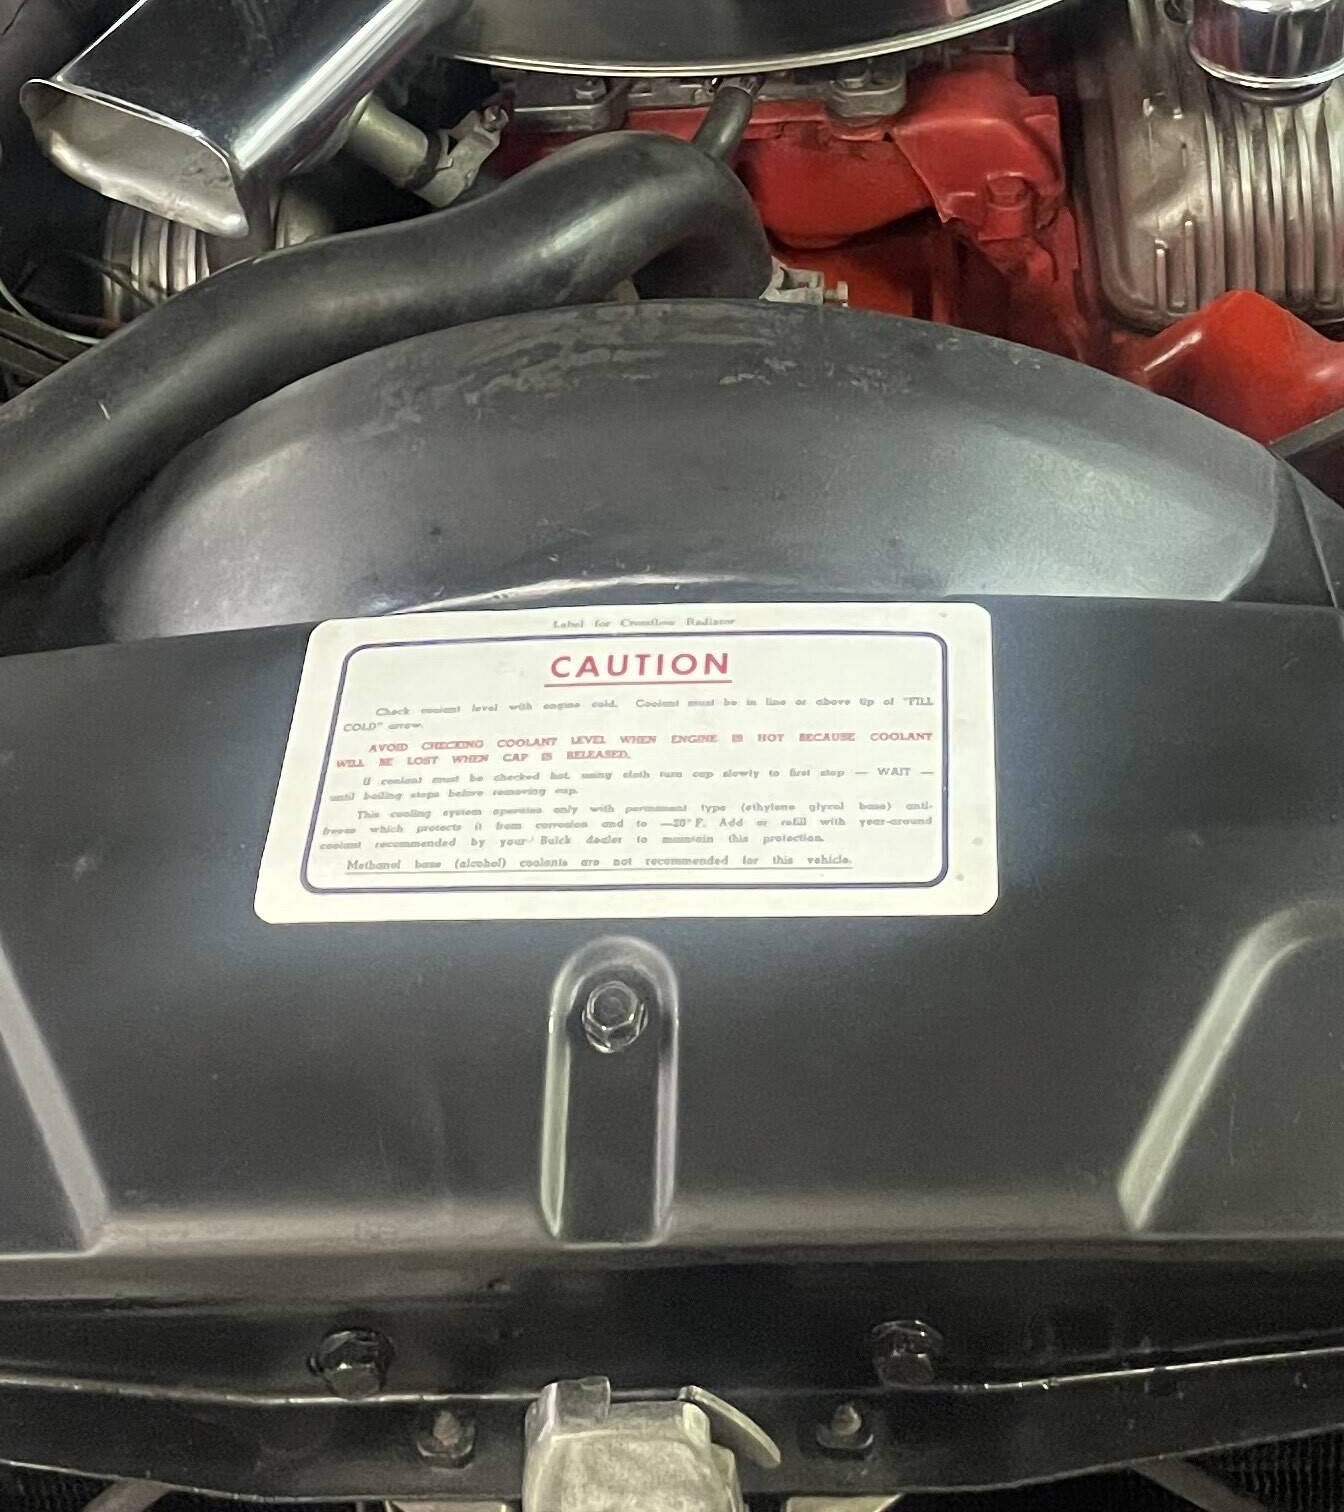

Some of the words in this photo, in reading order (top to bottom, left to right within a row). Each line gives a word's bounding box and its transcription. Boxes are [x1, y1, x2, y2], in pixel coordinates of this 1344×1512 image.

[550, 652, 729, 678] CAUTION
[369, 743, 408, 753] AVOID
[421, 740, 484, 750] CHECKING
[497, 738, 557, 748] COOLANT
[571, 736, 606, 745] LEVEL
[620, 735, 656, 744] WHEN
[671, 735, 718, 743] ENGINE
[731, 734, 743, 743] IS
[757, 734, 784, 742] HOT
[799, 733, 855, 742] BECAUSE
[870, 732, 933, 741] COOLANT
[346, 859, 401, 870] Methanol
[415, 859, 441, 869] base
[454, 858, 507, 869] (alcohol)
[519, 857, 568, 867] coolants
[581, 859, 600, 867] are
[613, 857, 632, 866] not
[645, 856, 728, 866] recommended
[742, 856, 759, 865] for
[773, 855, 793, 865] this
[807, 855, 852, 865] vehicle.
